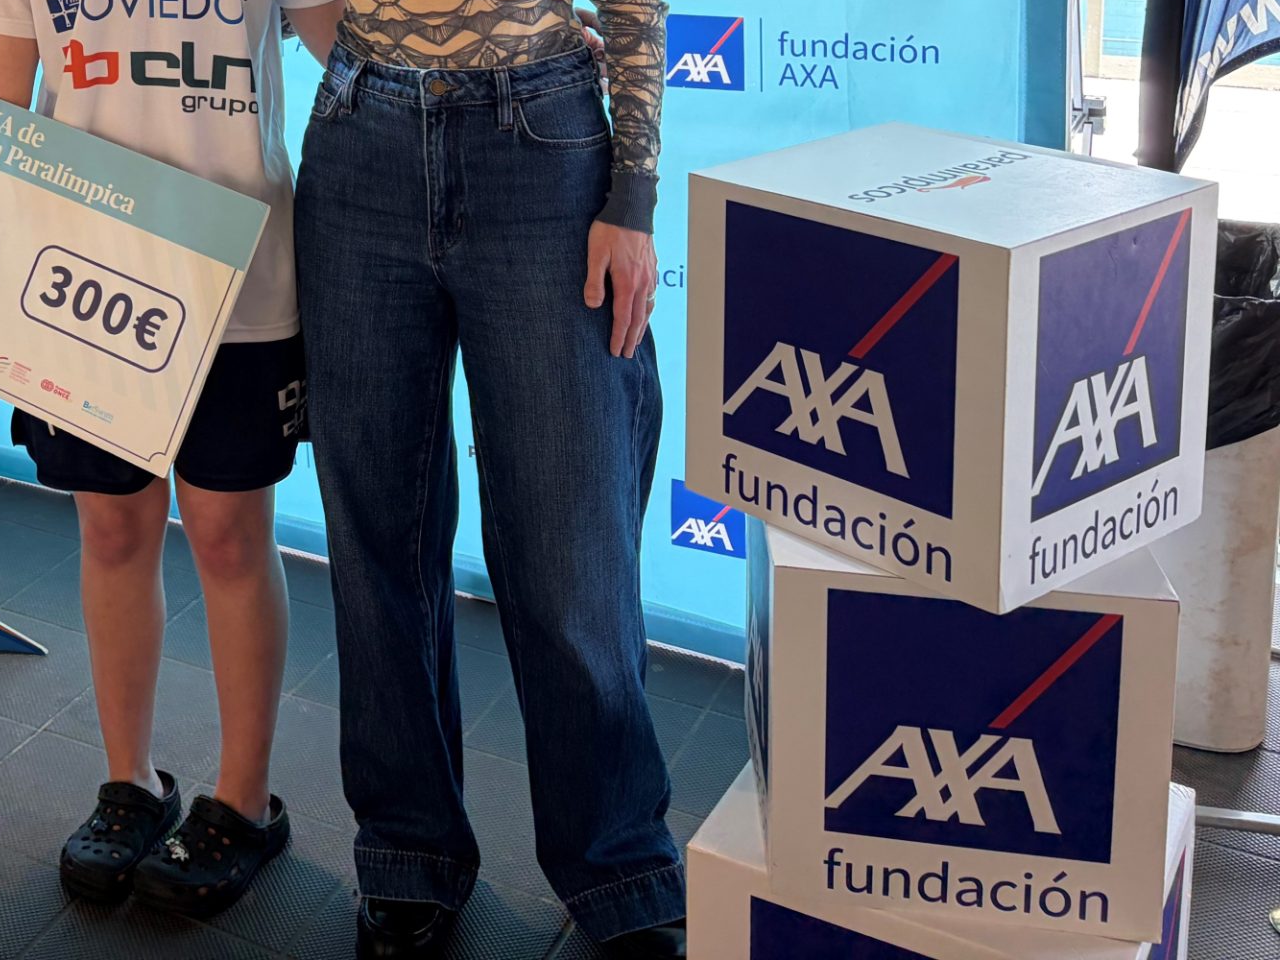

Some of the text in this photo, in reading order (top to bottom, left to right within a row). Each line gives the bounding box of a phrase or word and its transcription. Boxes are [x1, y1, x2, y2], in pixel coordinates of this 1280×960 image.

[666, 52, 731, 85] AXA
[777, 32, 941, 65] fundación
[779, 64, 839, 90] AXA
[18, 122, 45, 148] de
[4, 144, 135, 215] Paralímpica
[38, 265, 169, 352] 300€
[723, 341, 910, 479] AXA
[1033, 355, 1157, 498] AXA
[672, 517, 733, 552] AXA
[722, 453, 953, 583] fundación
[1029, 479, 1180, 585] fundación
[825, 725, 1062, 836] AXA
[824, 847, 1110, 924] fundación
